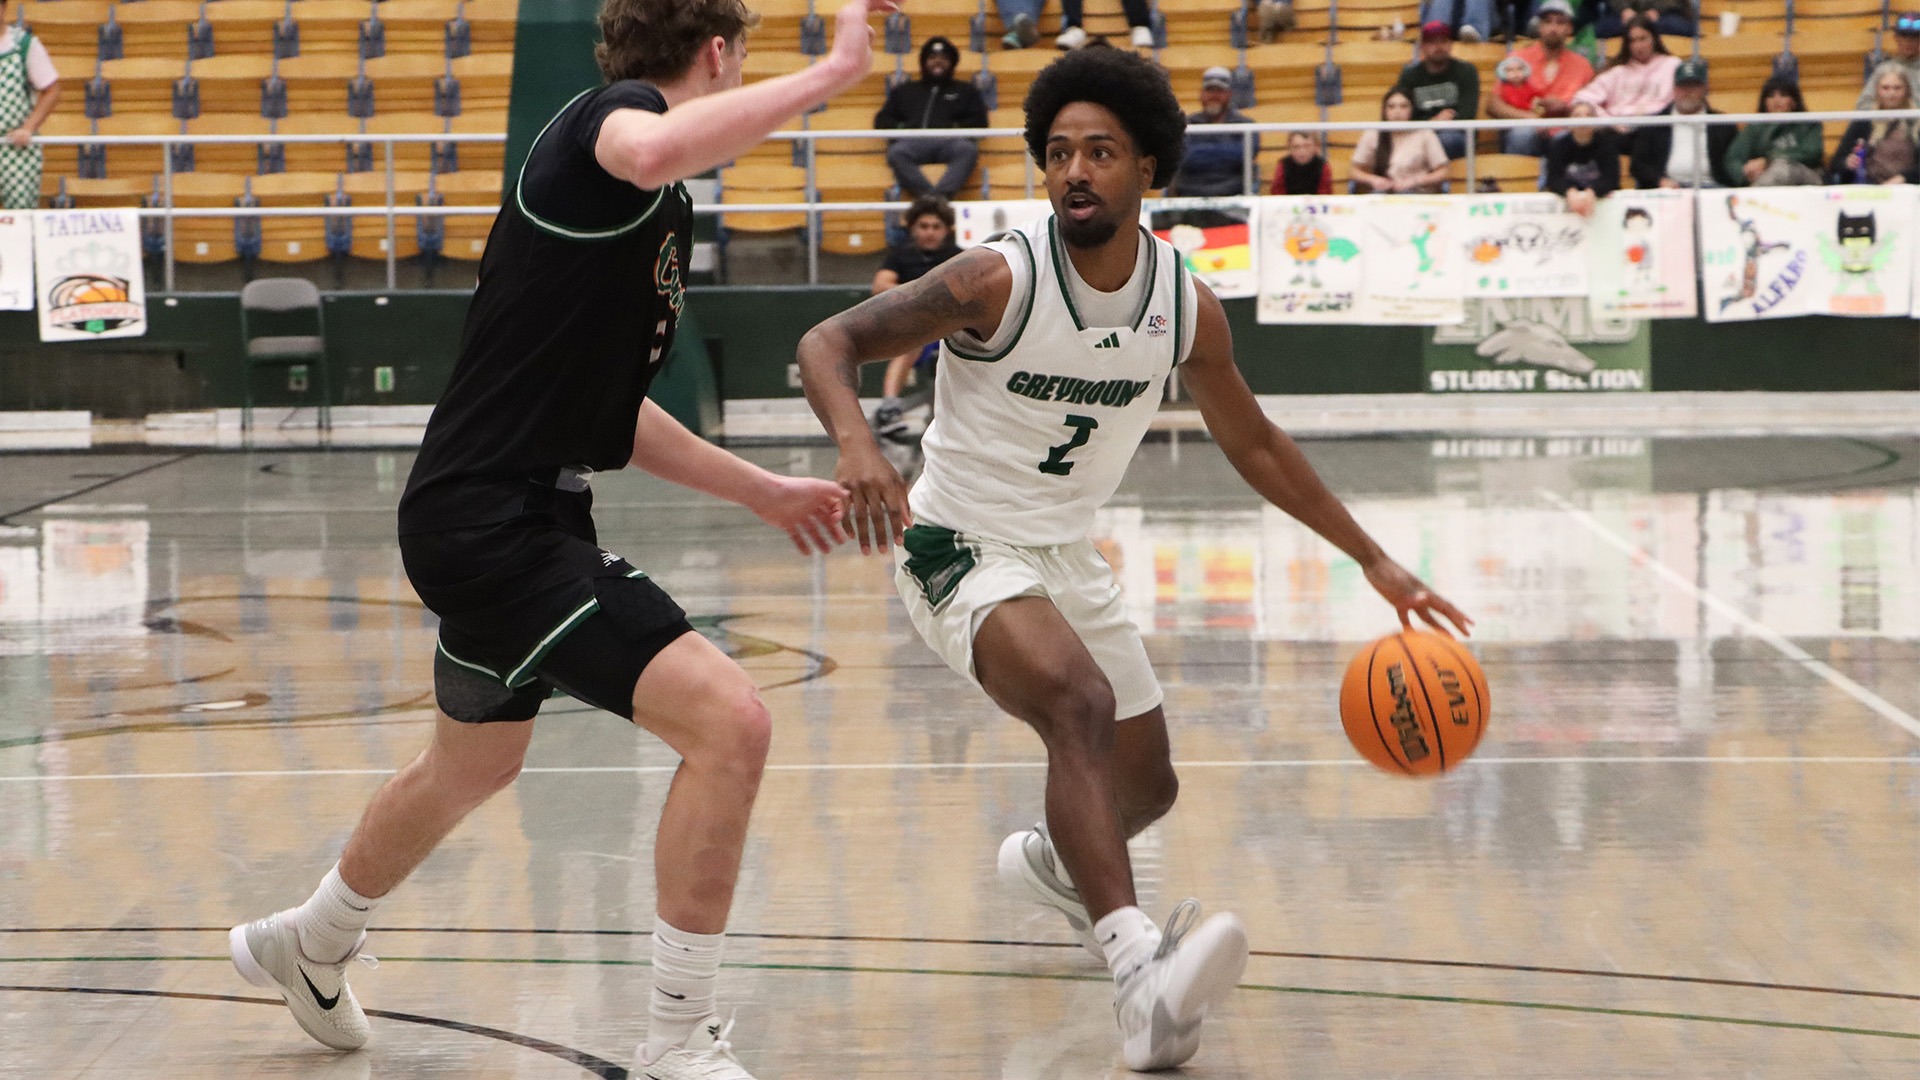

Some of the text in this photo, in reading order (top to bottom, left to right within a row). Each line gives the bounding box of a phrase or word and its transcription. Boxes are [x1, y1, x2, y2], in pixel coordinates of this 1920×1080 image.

[45, 213, 124, 237] TATIANA
[1751, 249, 1808, 314] ALFARO
[1430, 370, 1538, 390] STUDENT
[1038, 414, 1099, 476] 2
